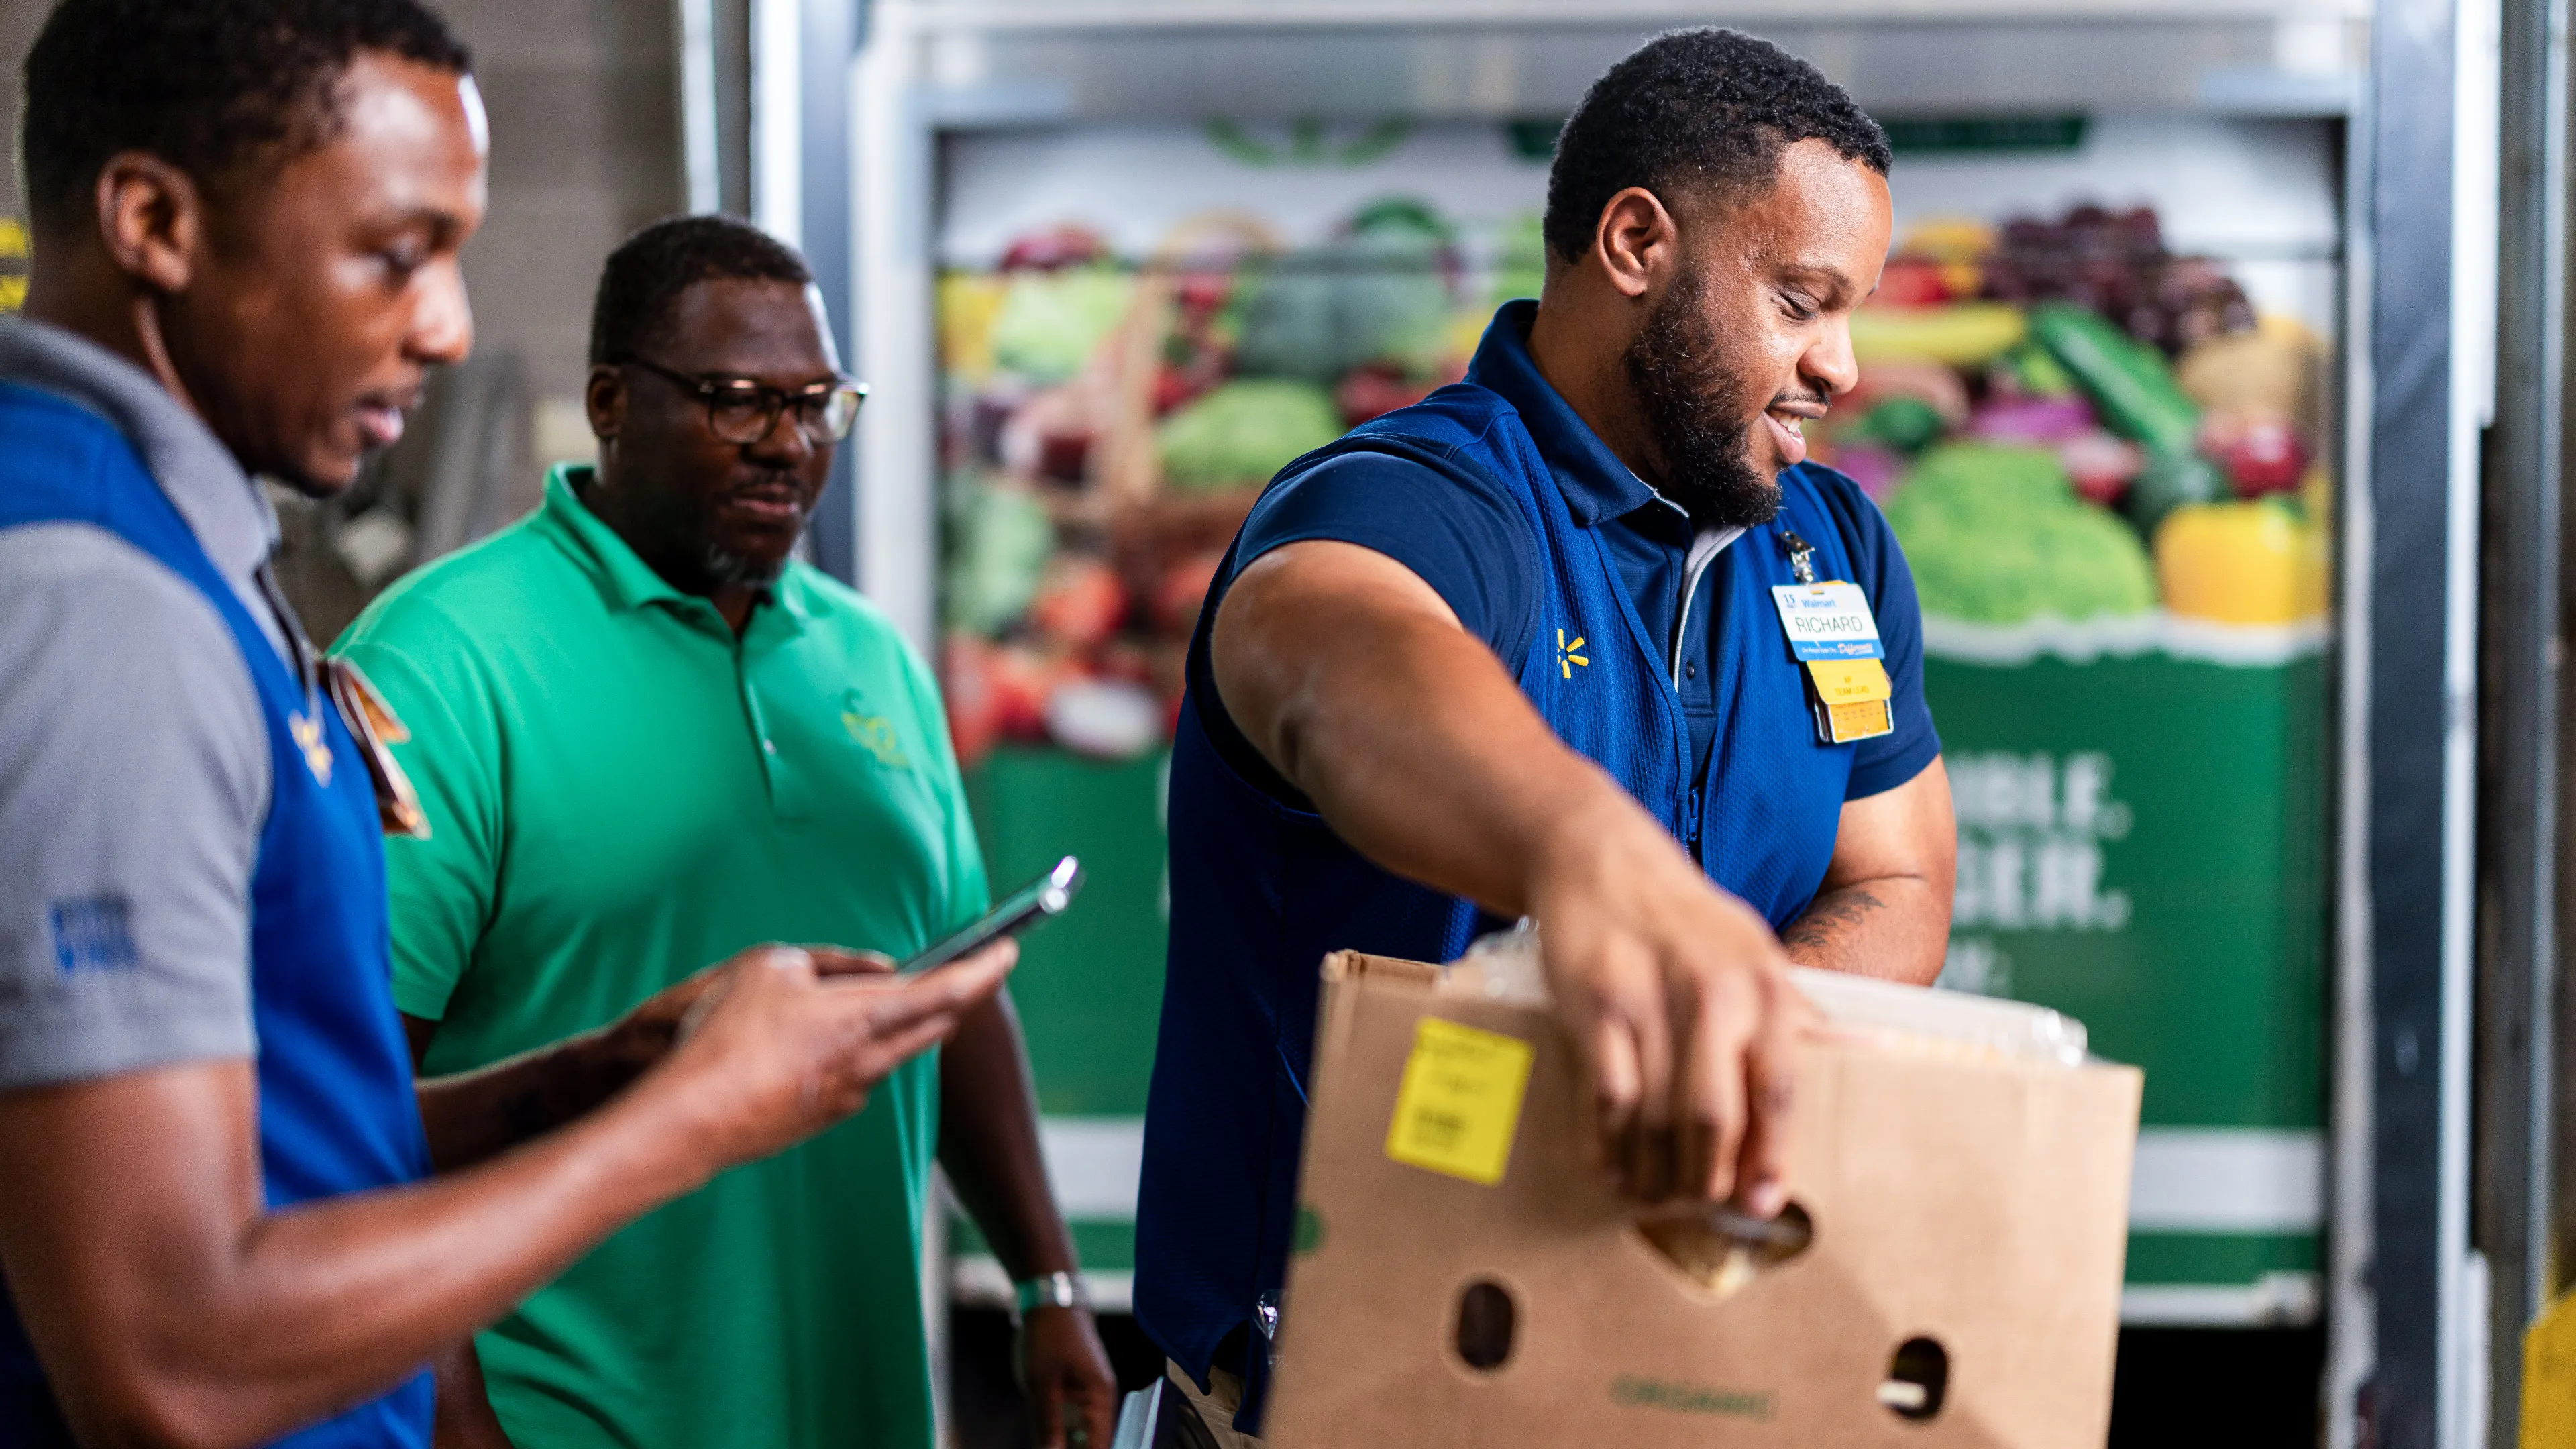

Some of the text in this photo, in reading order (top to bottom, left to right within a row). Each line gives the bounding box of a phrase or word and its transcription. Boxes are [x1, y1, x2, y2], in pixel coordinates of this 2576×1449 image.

[1801, 599, 1836, 608] Walmart
[1795, 616, 1862, 633] RICHARD
[1834, 685, 1870, 696] TEAM LEAD
